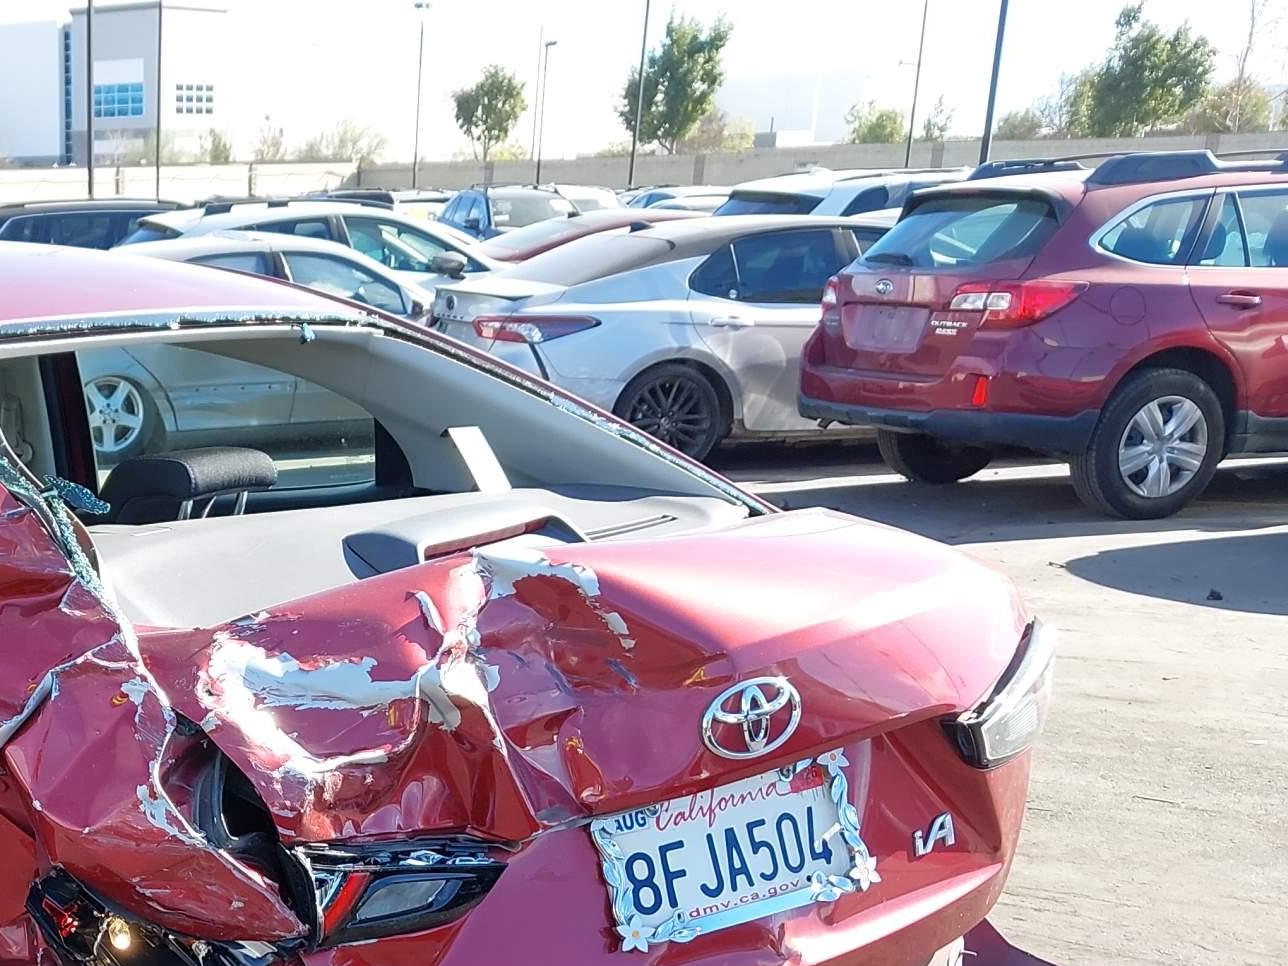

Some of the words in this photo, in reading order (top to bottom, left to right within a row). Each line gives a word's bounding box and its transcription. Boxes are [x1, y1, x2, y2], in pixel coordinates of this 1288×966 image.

[930, 320, 969, 329] OUTBACK
[615, 810, 647, 832] AUG
[655, 776, 792, 831] California
[914, 811, 955, 857] iA
[624, 805, 833, 916] 8FJA504
[689, 879, 801, 919] dmv.ca.gov
